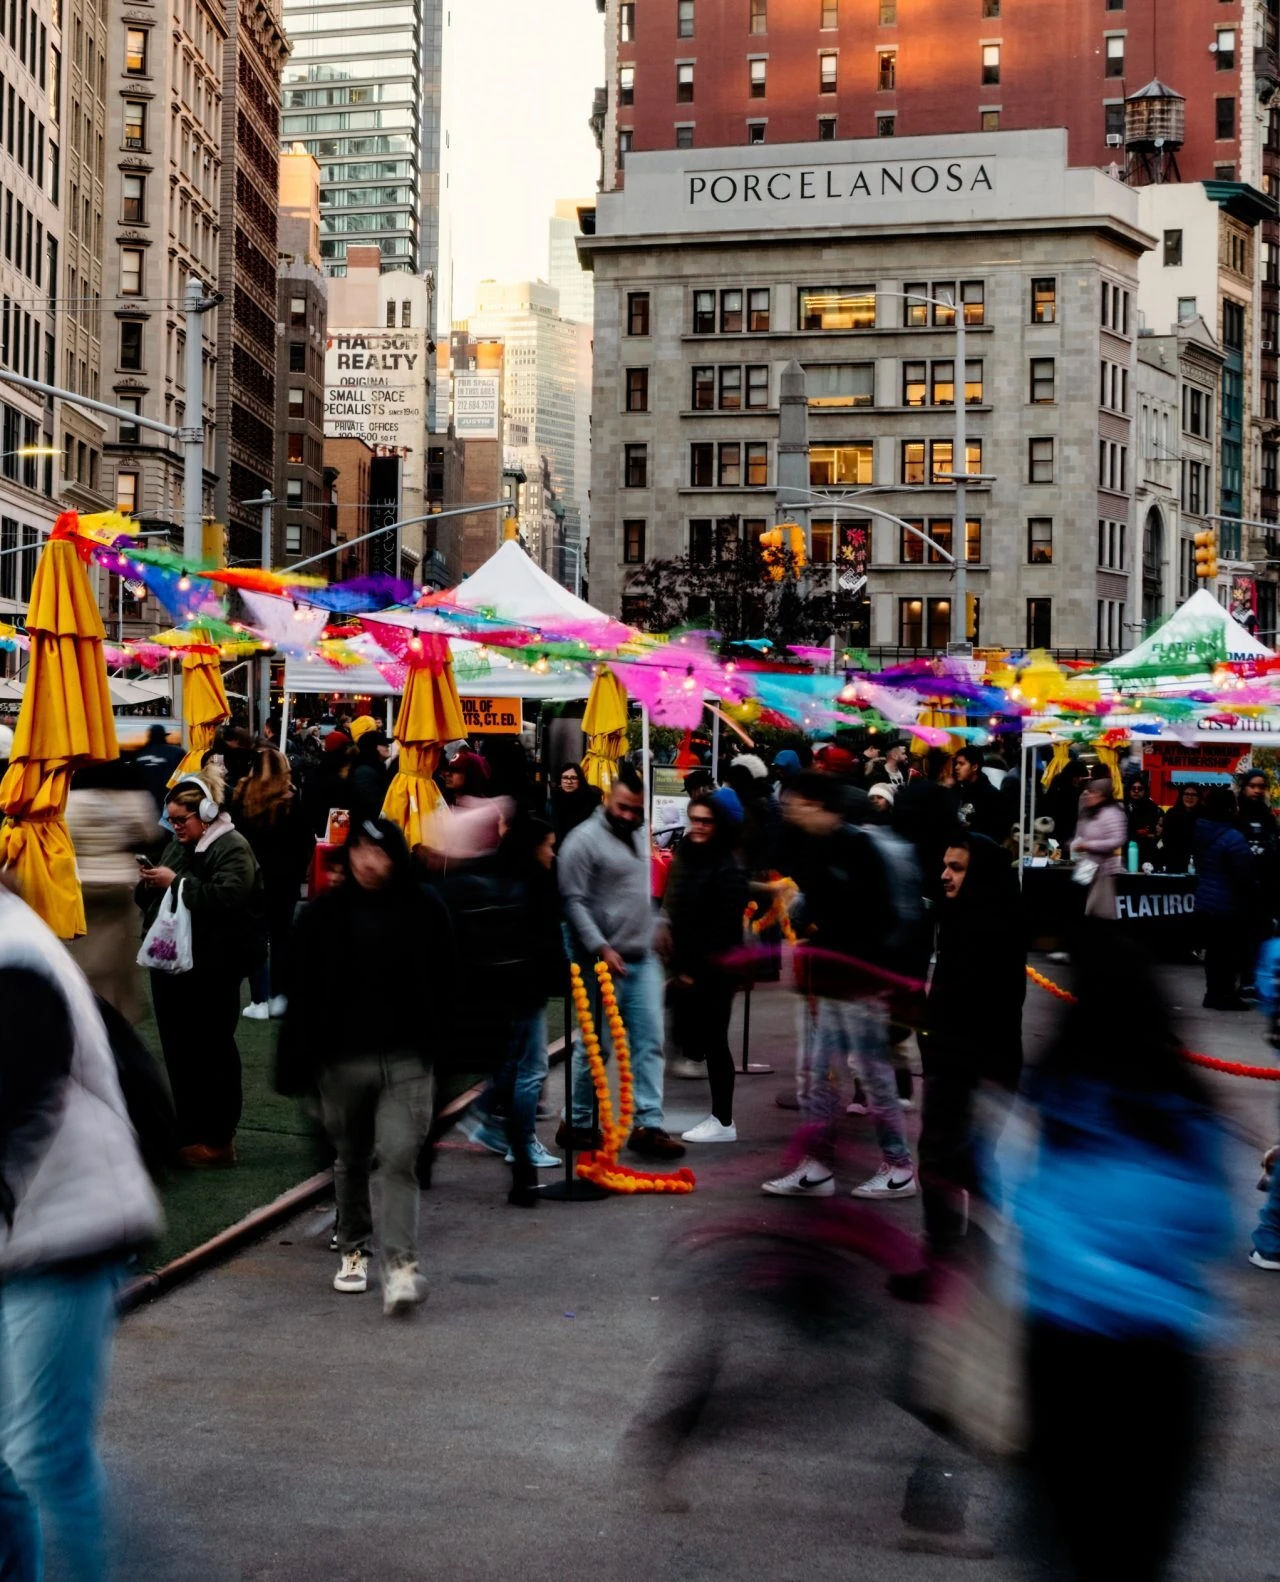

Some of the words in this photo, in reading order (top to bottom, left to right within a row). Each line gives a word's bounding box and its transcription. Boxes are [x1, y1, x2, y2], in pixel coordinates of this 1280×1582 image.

[689, 163, 993, 204] PORCELANOSA
[337, 354, 418, 370] REALTY
[329, 390, 366, 402] SMALL
[371, 390, 405, 403] SPACE
[335, 422, 365, 432] PRIVATE
[369, 422, 399, 432] OFFICES
[383, 497, 396, 577] BROADW
[480, 700, 492, 712] OF
[484, 713, 500, 726] CT.
[501, 713, 517, 726] ED.
[1115, 894, 1195, 920] FLATIRO
